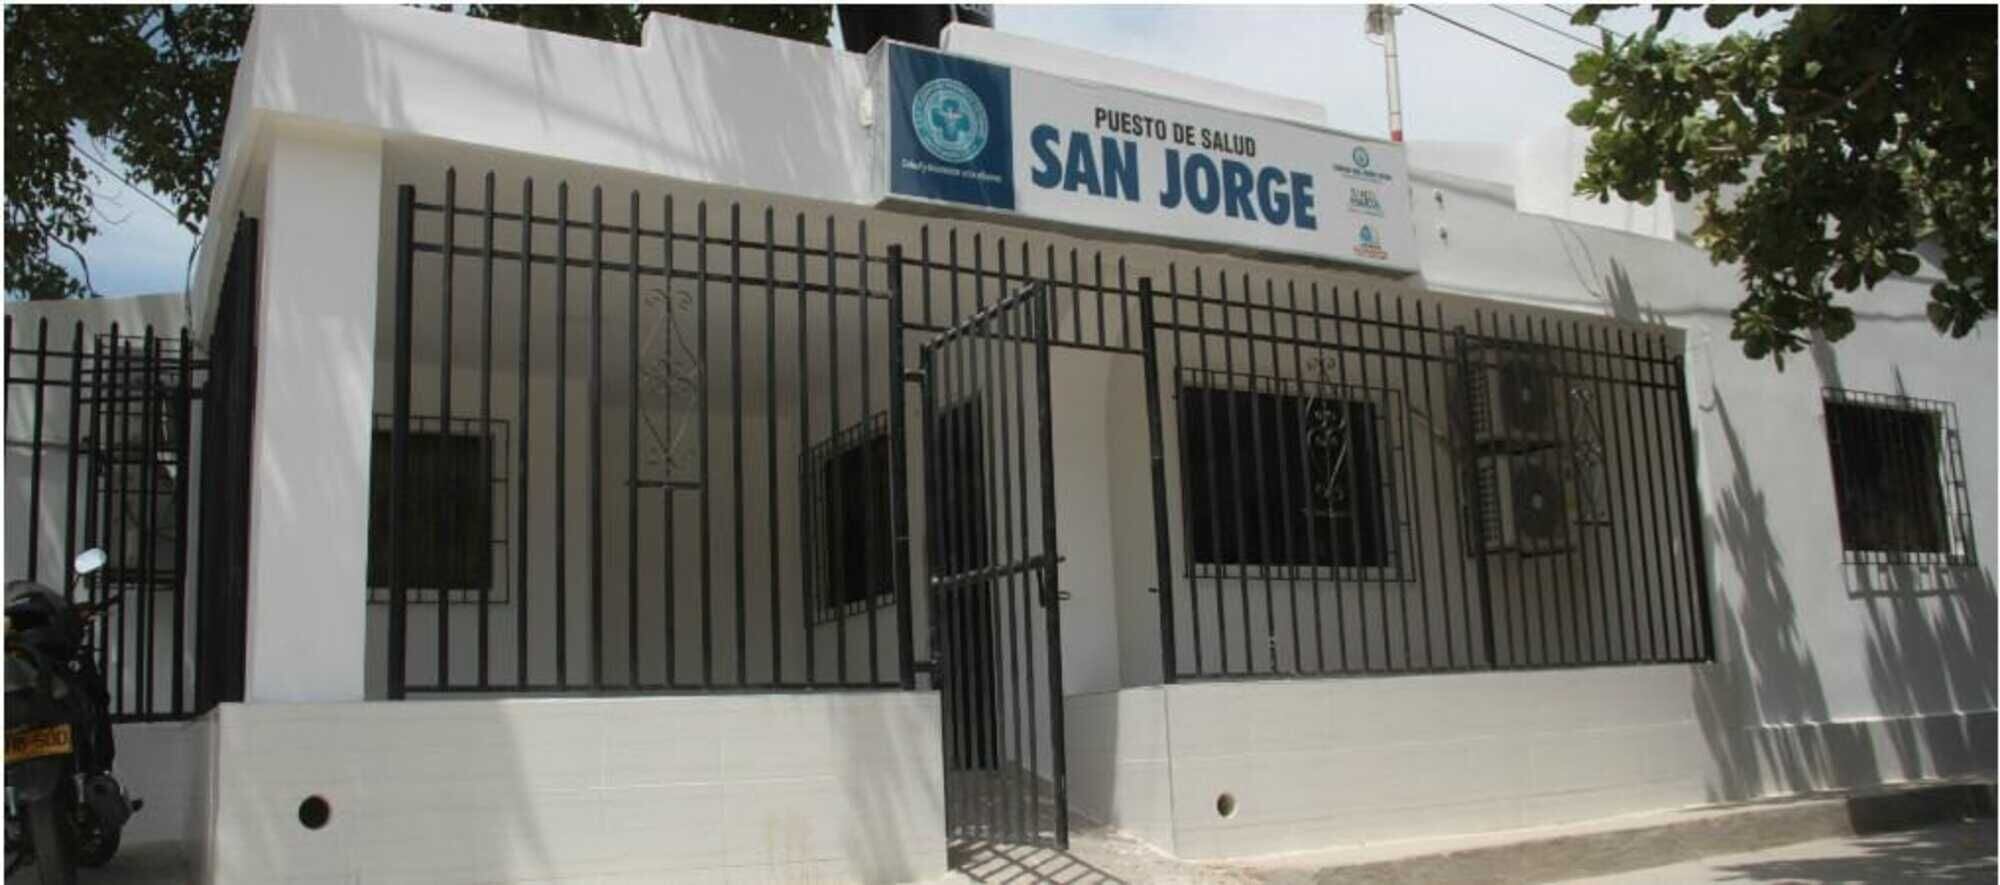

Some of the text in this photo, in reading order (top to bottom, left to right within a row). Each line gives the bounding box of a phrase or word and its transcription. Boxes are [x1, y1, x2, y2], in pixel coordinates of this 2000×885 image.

[1094, 107, 1257, 158] PUESTO DE SALUD
[1030, 123, 1318, 231] SAN JORGE
